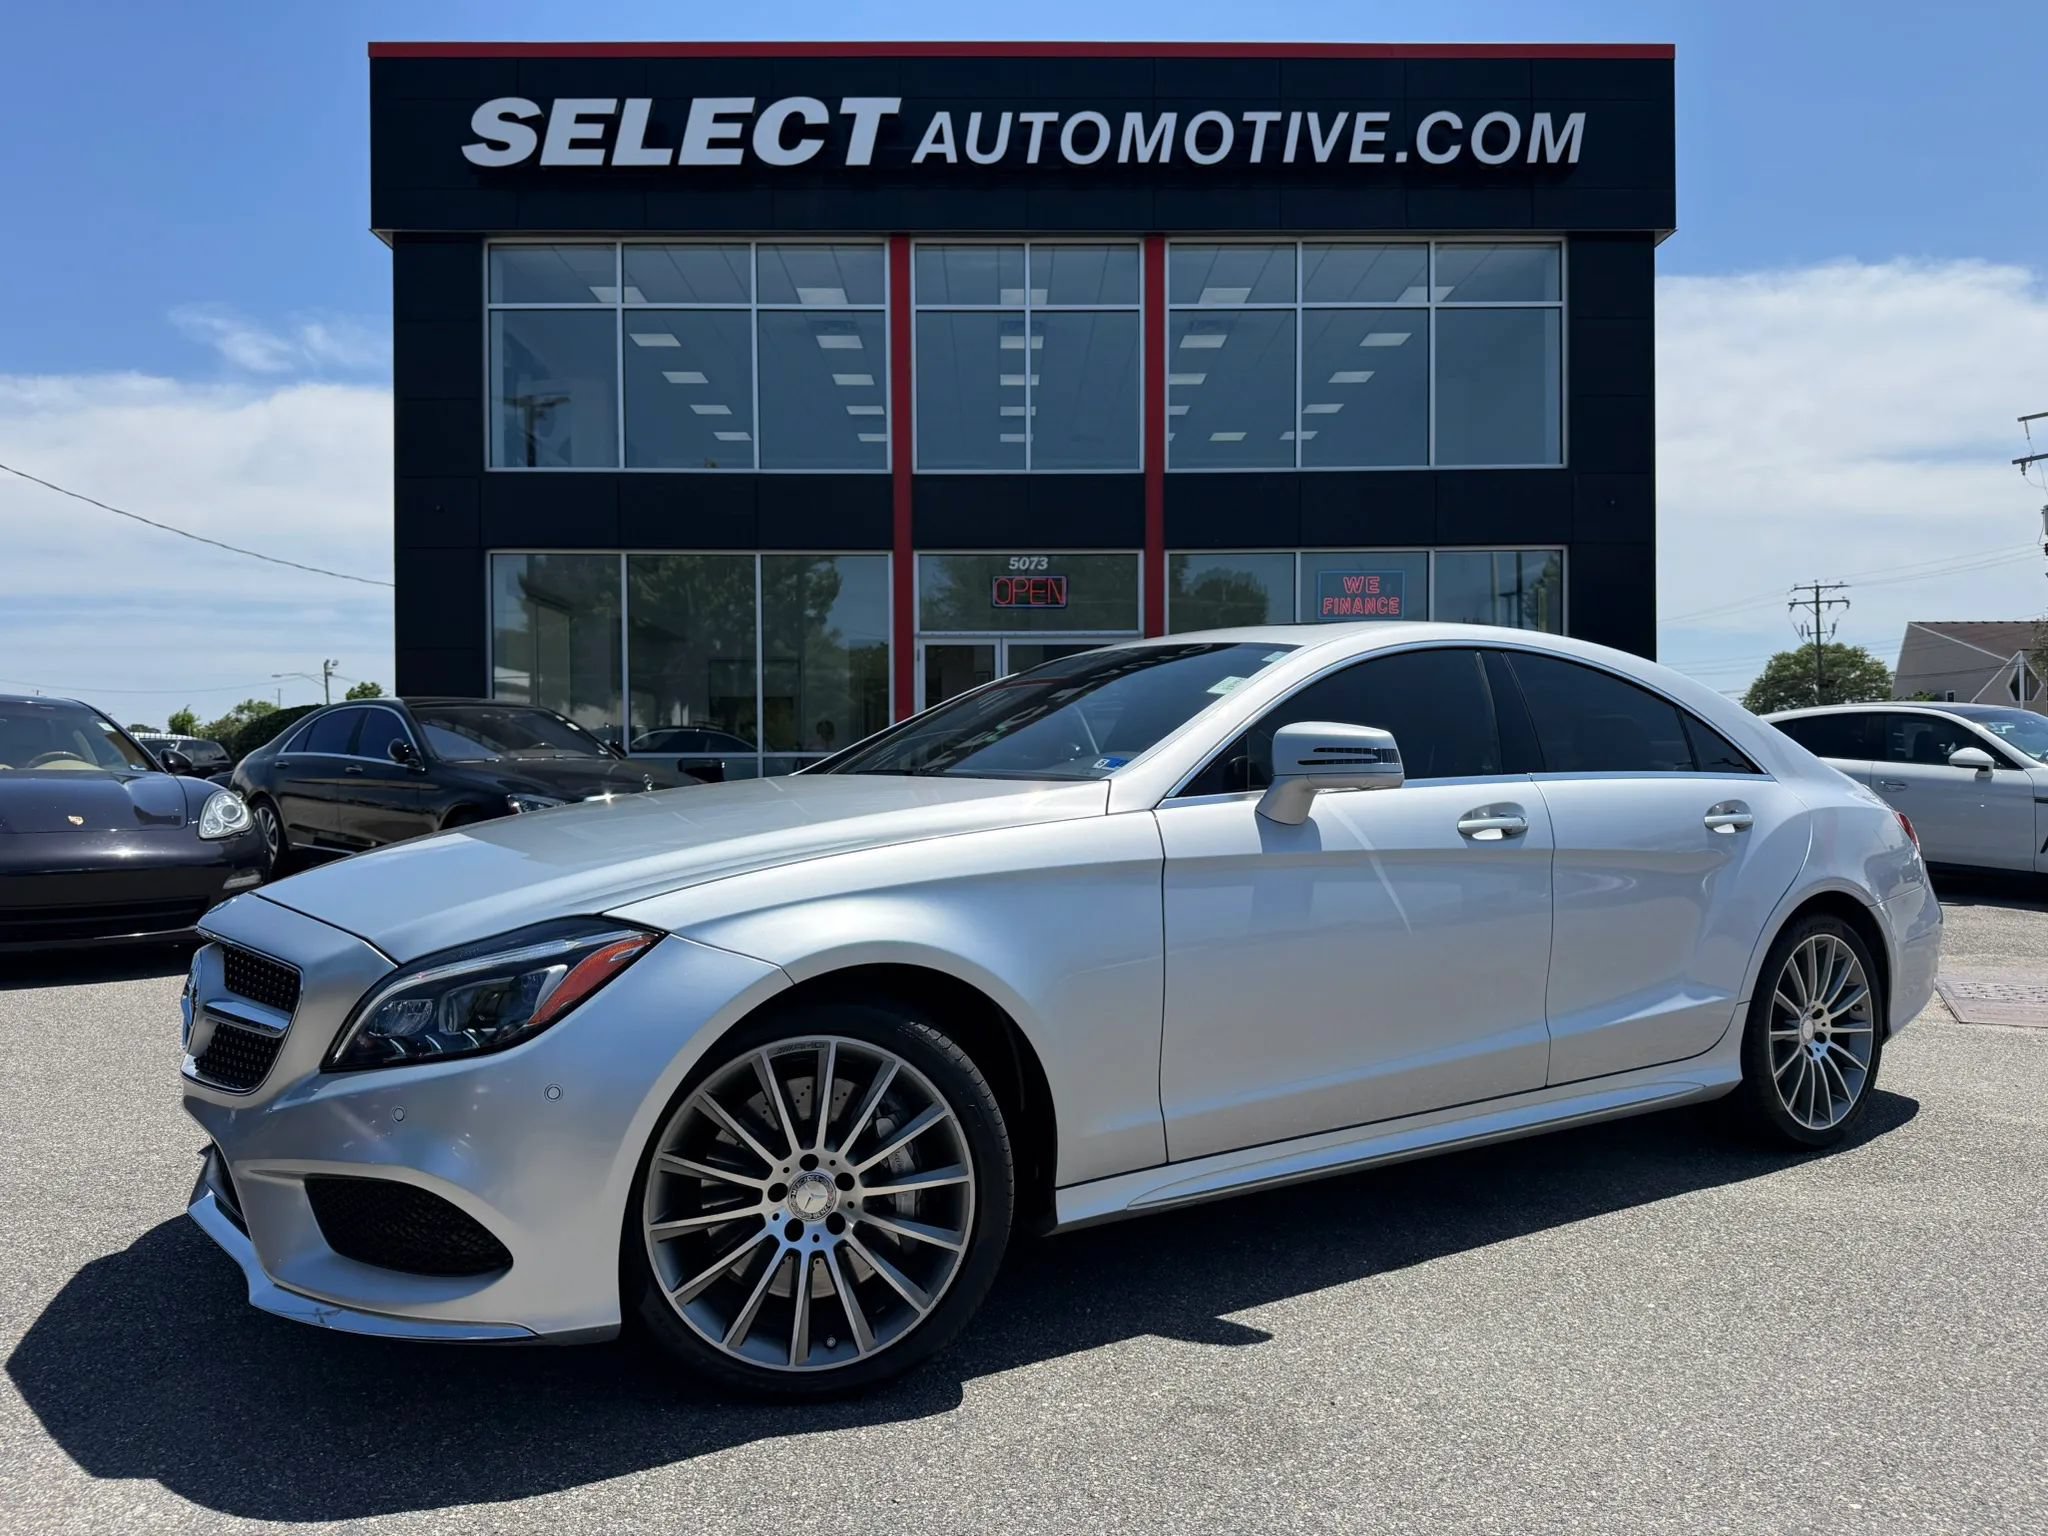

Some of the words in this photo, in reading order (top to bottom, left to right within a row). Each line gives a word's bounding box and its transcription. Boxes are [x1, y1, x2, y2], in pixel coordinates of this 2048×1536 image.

[461, 97, 902, 167] SELECT
[911, 110, 1586, 165] AUTOMOTIVE.COM
[1008, 557, 1049, 570] 5073
[995, 576, 1066, 605] OPEN
[1342, 576, 1380, 594] WE
[1322, 597, 1400, 615] FINANCE
